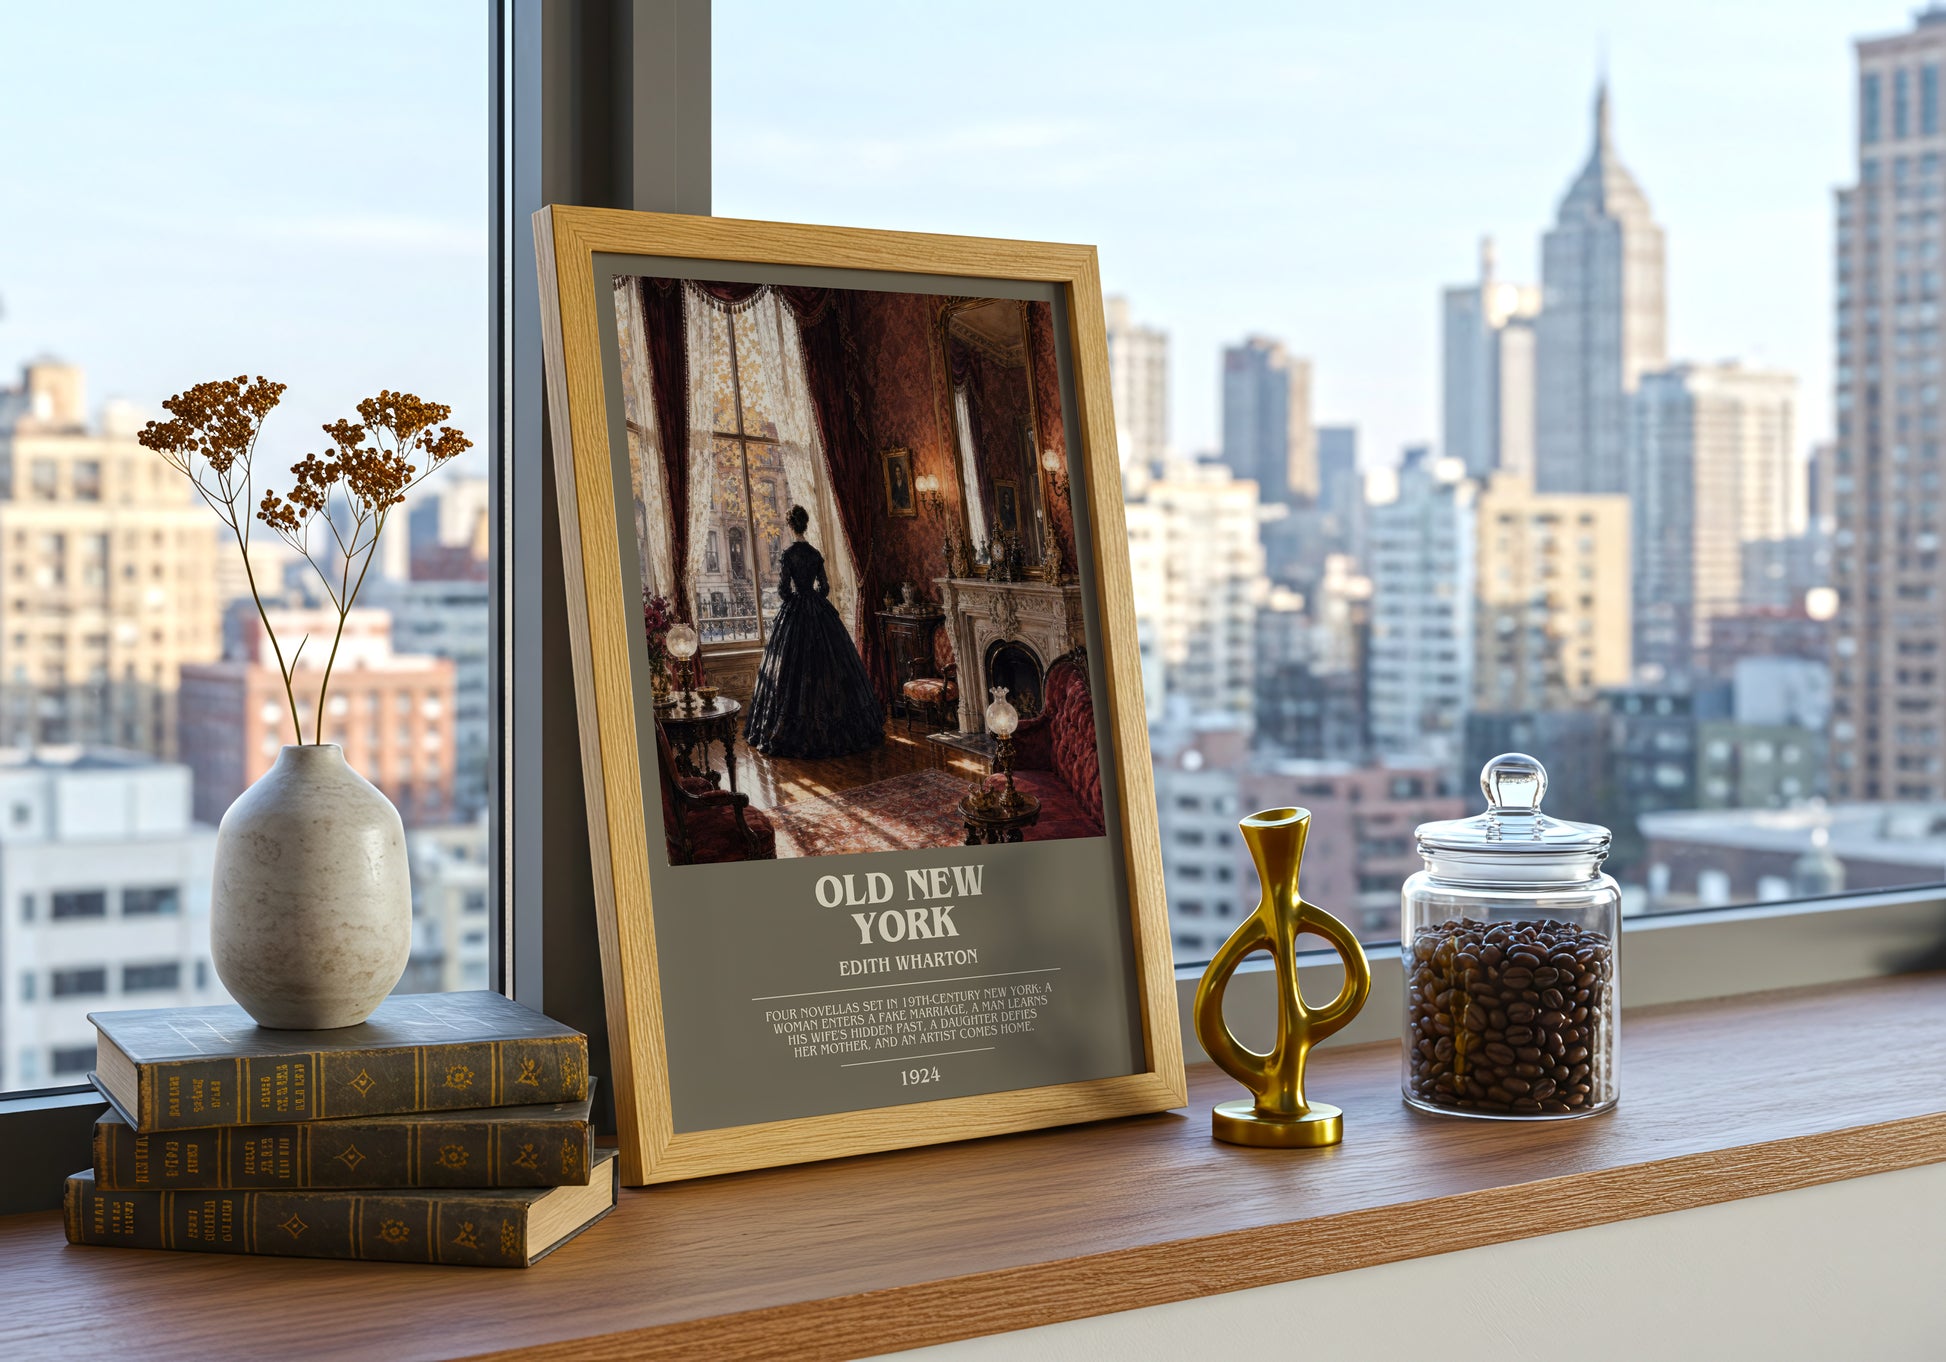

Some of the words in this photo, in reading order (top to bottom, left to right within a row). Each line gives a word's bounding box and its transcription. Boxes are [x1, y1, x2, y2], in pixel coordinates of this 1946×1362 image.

[814, 872, 894, 908] OLD
[904, 864, 985, 901] NEW
[850, 905, 961, 945] YORK
[839, 956, 891, 977] EDITH
[894, 948, 979, 971] WHARTON
[765, 1008, 798, 1023] FOUR
[800, 1001, 860, 1019] NOVELLAS
[862, 999, 884, 1012] SET
[886, 998, 898, 1010] IN
[902, 989, 981, 1008] 19TH-CENTURY
[983, 986, 1007, 999] NEW
[1010, 983, 1042, 996] YORK:
[1044, 982, 1053, 993] A
[773, 1019, 818, 1035] WOMAN
[821, 1014, 865, 1029] ENTERS
[868, 1013, 876, 1025] A
[878, 1009, 907, 1023] FAKE
[909, 1003, 969, 1020] MARRIAGE,
[971, 1002, 980, 1013] A
[981, 999, 1005, 1012] MAN
[1007, 994, 1048, 1009] LEARNS
[787, 1033, 808, 1046] HIS
[810, 1029, 848, 1044] WIFE'S
[850, 1023, 893, 1039] HIDDEN
[896, 1020, 927, 1034] PAST,
[929, 1019, 938, 1031] A
[940, 1012, 999, 1029] DAUGHTER
[1000, 1008, 1038, 1022] DEFIES
[794, 1045, 818, 1059] HER
[820, 1039, 871, 1056] MOTHER,
[874, 1036, 898, 1049] AND
[901, 1033, 917, 1046] AN
[919, 1027, 957, 1044] ARTIST
[959, 1024, 998, 1040] COMES
[1000, 1020, 1035, 1035] HOME.
[901, 1065, 941, 1086] 1924
